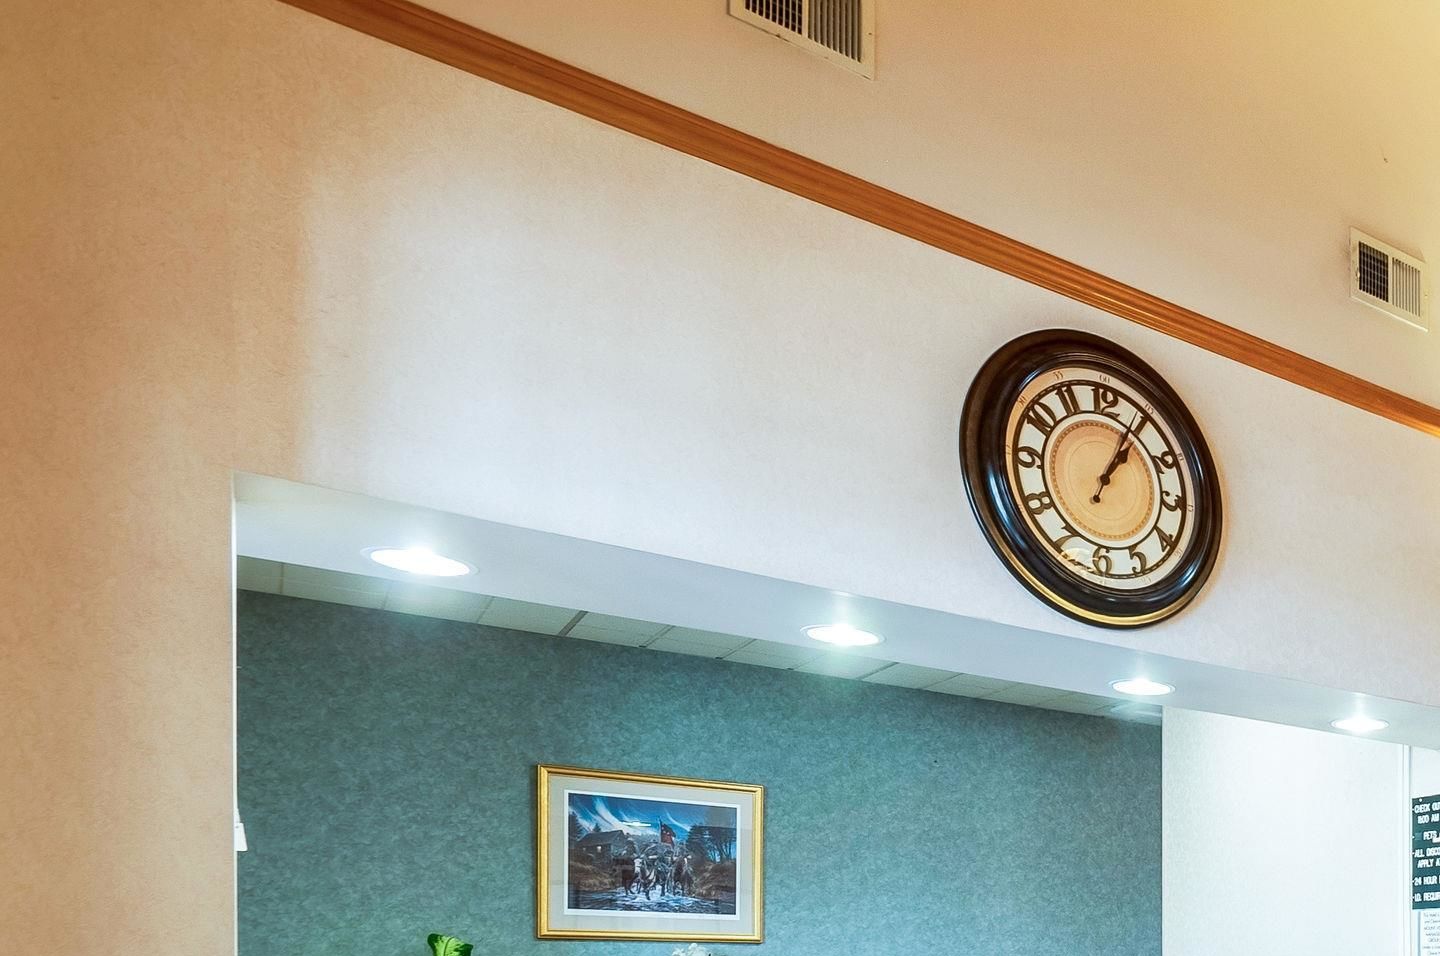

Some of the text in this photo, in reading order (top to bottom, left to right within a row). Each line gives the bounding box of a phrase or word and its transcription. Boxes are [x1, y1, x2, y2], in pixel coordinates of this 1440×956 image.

[1055, 384, 1081, 417] 11
[1091, 385, 1121, 419] 12
[1025, 400, 1057, 436] 10
[1133, 415, 1149, 437] 1
[1017, 446, 1043, 469] 9
[1151, 450, 1175, 475] 2
[1025, 491, 1053, 515] 8
[1161, 490, 1184, 512] 3
[1155, 525, 1176, 553] 4
[1093, 546, 1113, 575] 6
[1128, 545, 1147, 575] 5
[1430, 813, 1440, 823] AM
[1423, 830, 1437, 841] PETS
[1417, 858, 1434, 869] APPLY
[1423, 875, 1438, 885] HOUR
